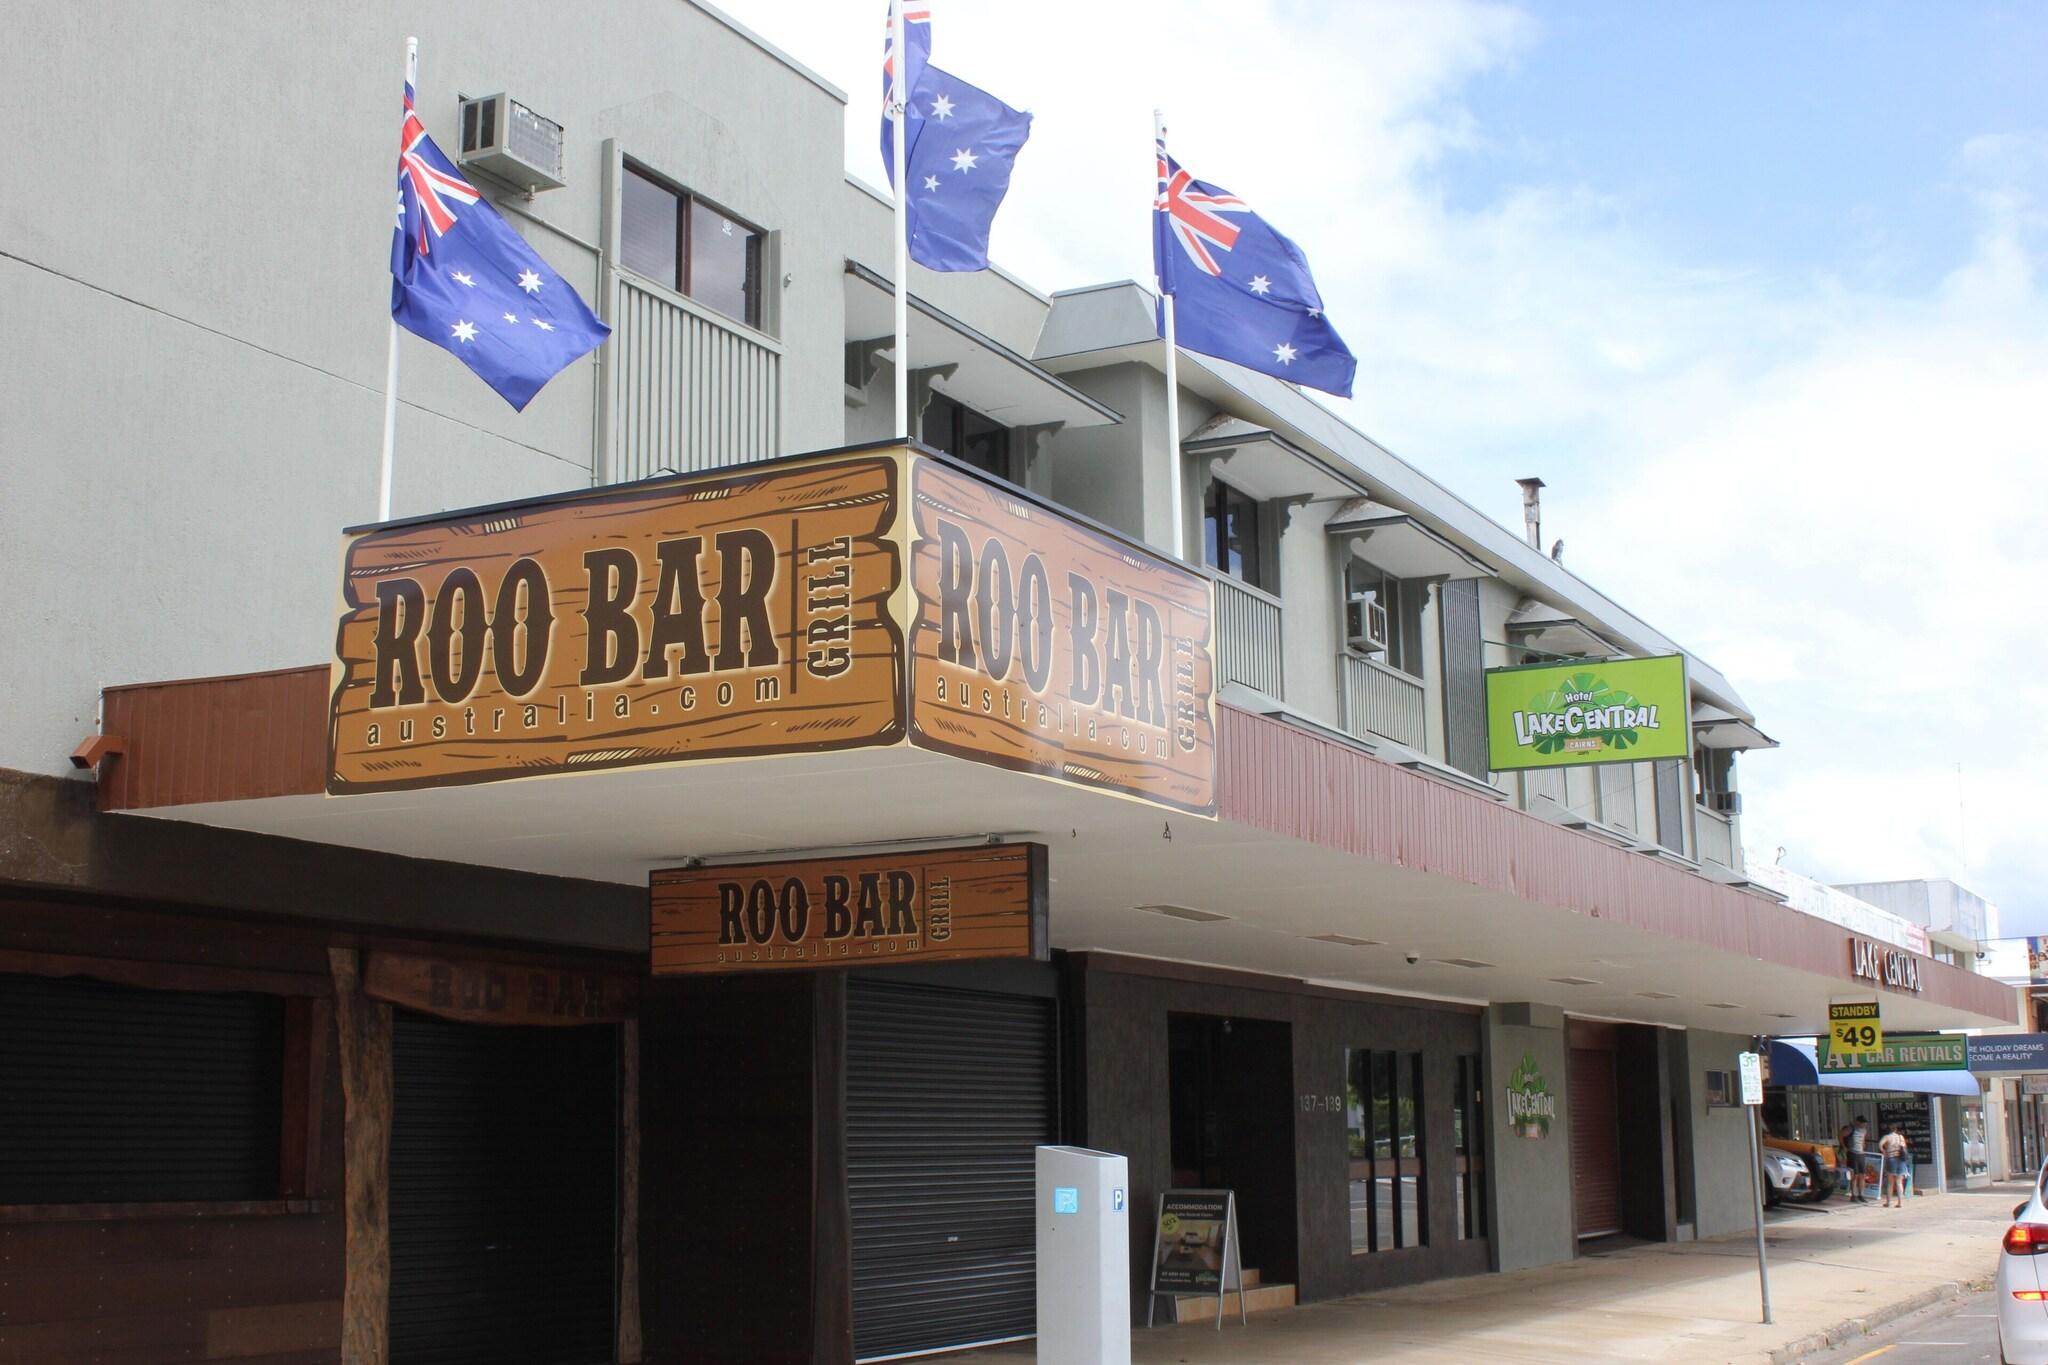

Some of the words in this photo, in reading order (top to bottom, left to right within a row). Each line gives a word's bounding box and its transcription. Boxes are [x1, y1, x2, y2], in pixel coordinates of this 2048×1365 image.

[368, 557, 556, 710] ROO
[578, 527, 785, 688] BAR
[805, 534, 853, 679] GRILL
[937, 518, 1054, 694] ROO
[1067, 571, 1168, 730] BAR
[366, 673, 781, 747] australia.com
[936, 674, 1168, 760] australia.com
[1175, 635, 1196, 752] GRILL
[1565, 691, 1594, 703] Hotel
[1569, 740, 1597, 750] CAIRNS
[717, 877, 811, 946] ROO
[823, 869, 920, 941] BAR
[929, 876, 952, 942] GRILL
[717, 938, 920, 963] australia.com
[1850, 937, 1880, 980] LAKE
[1883, 948, 1923, 992] CENTRAL
[1831, 1005, 1877, 1018] STANDBY
[1836, 1026, 1876, 1047] $49
[1866, 1047, 1896, 1063] CAR
[1899, 1045, 1963, 1063] RENTALS
[1979, 1045, 2012, 1053] HOLIDAY
[2013, 1043, 2045, 1052] DREAMS
